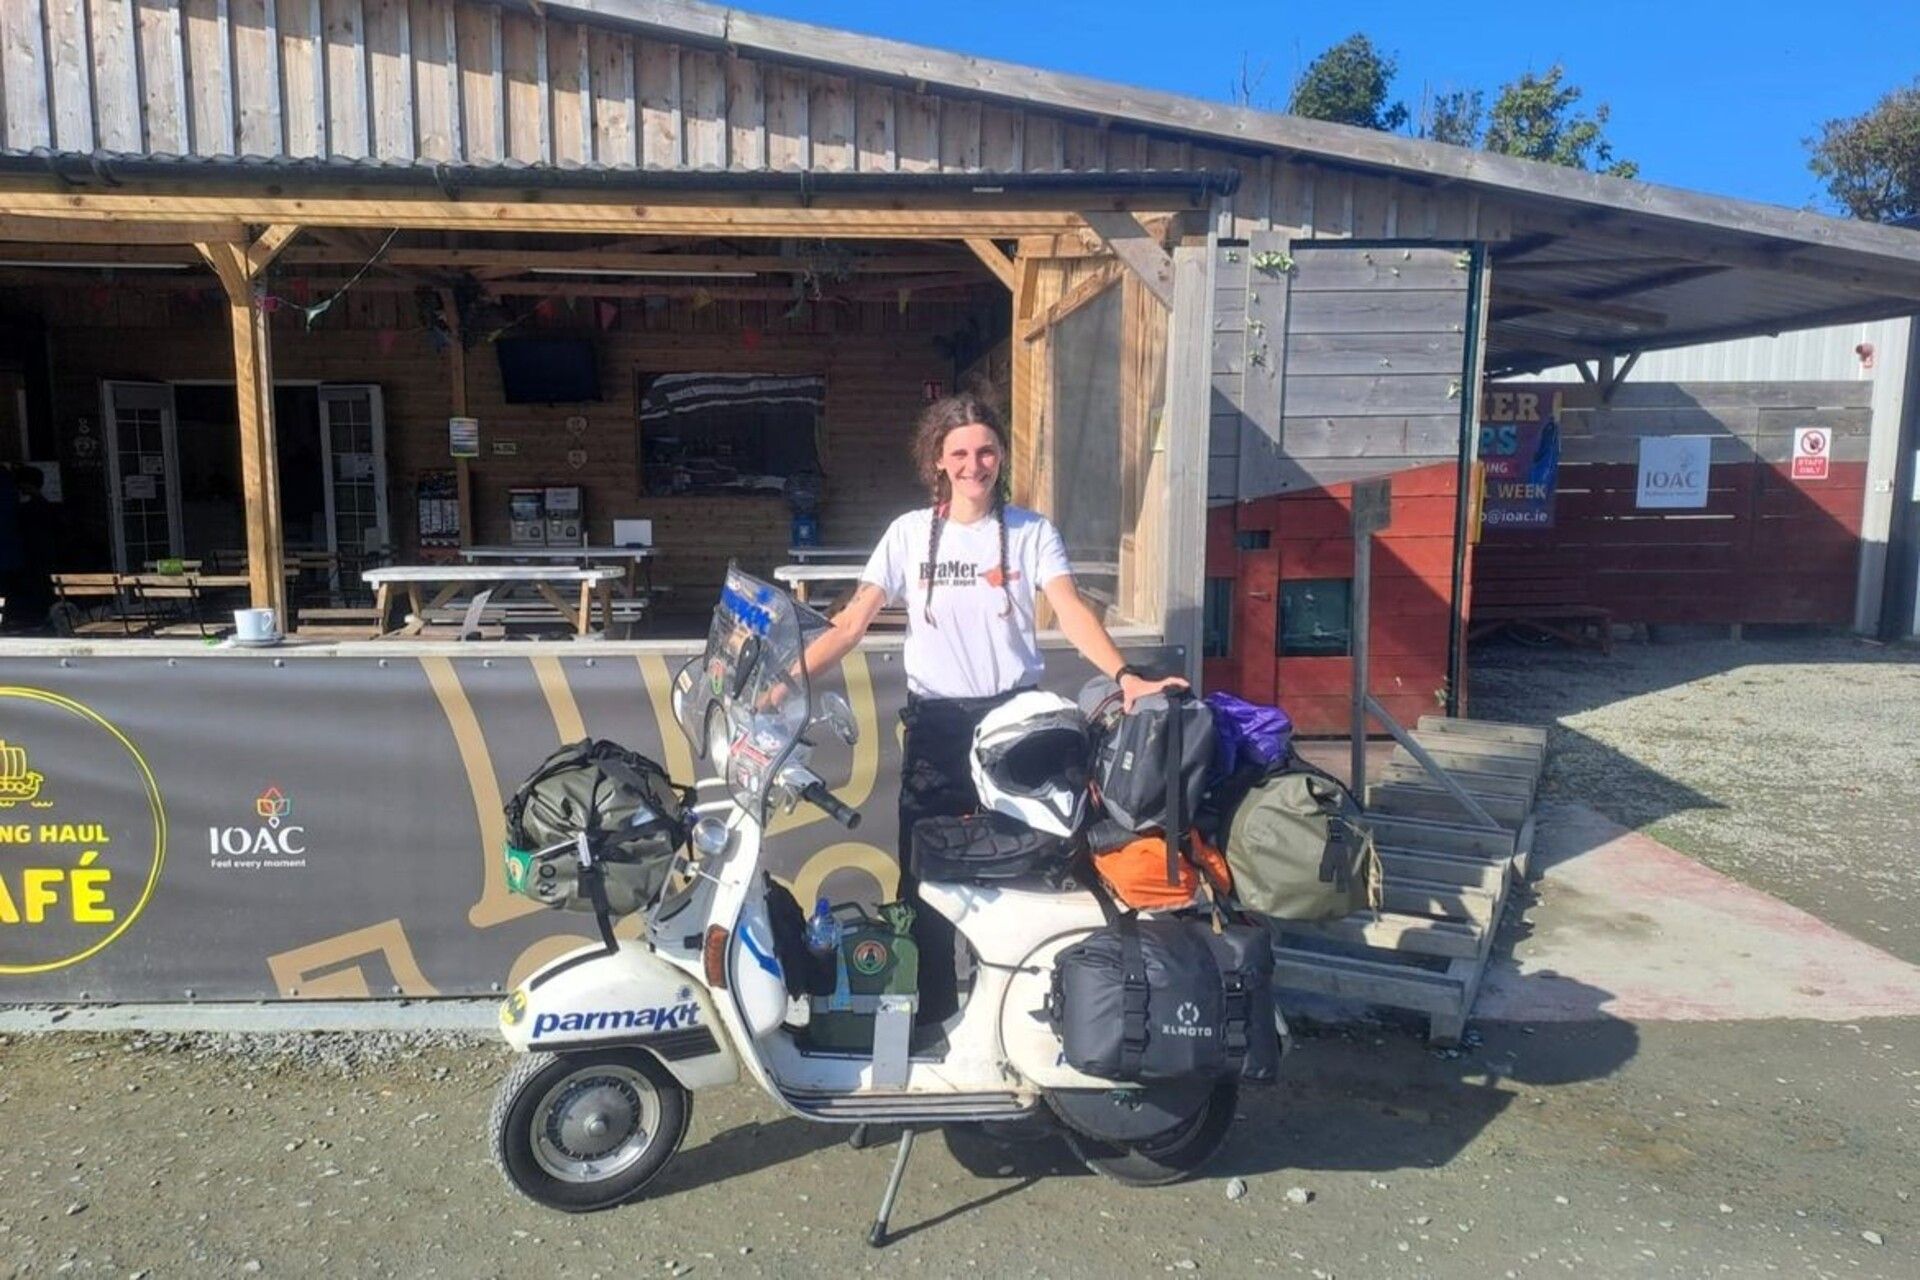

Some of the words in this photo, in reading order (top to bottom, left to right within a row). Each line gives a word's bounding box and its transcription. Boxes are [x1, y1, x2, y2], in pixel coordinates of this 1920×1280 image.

[1645, 471, 1699, 488] IOAC
[1498, 483, 1547, 499] WEEK
[40, 824, 110, 843] HAUL
[210, 826, 305, 855] IOAC
[211, 859, 232, 868] Feel
[234, 860, 261, 870] every
[263, 859, 306, 868] moment
[1161, 1024, 1212, 1036] XLMOTO
